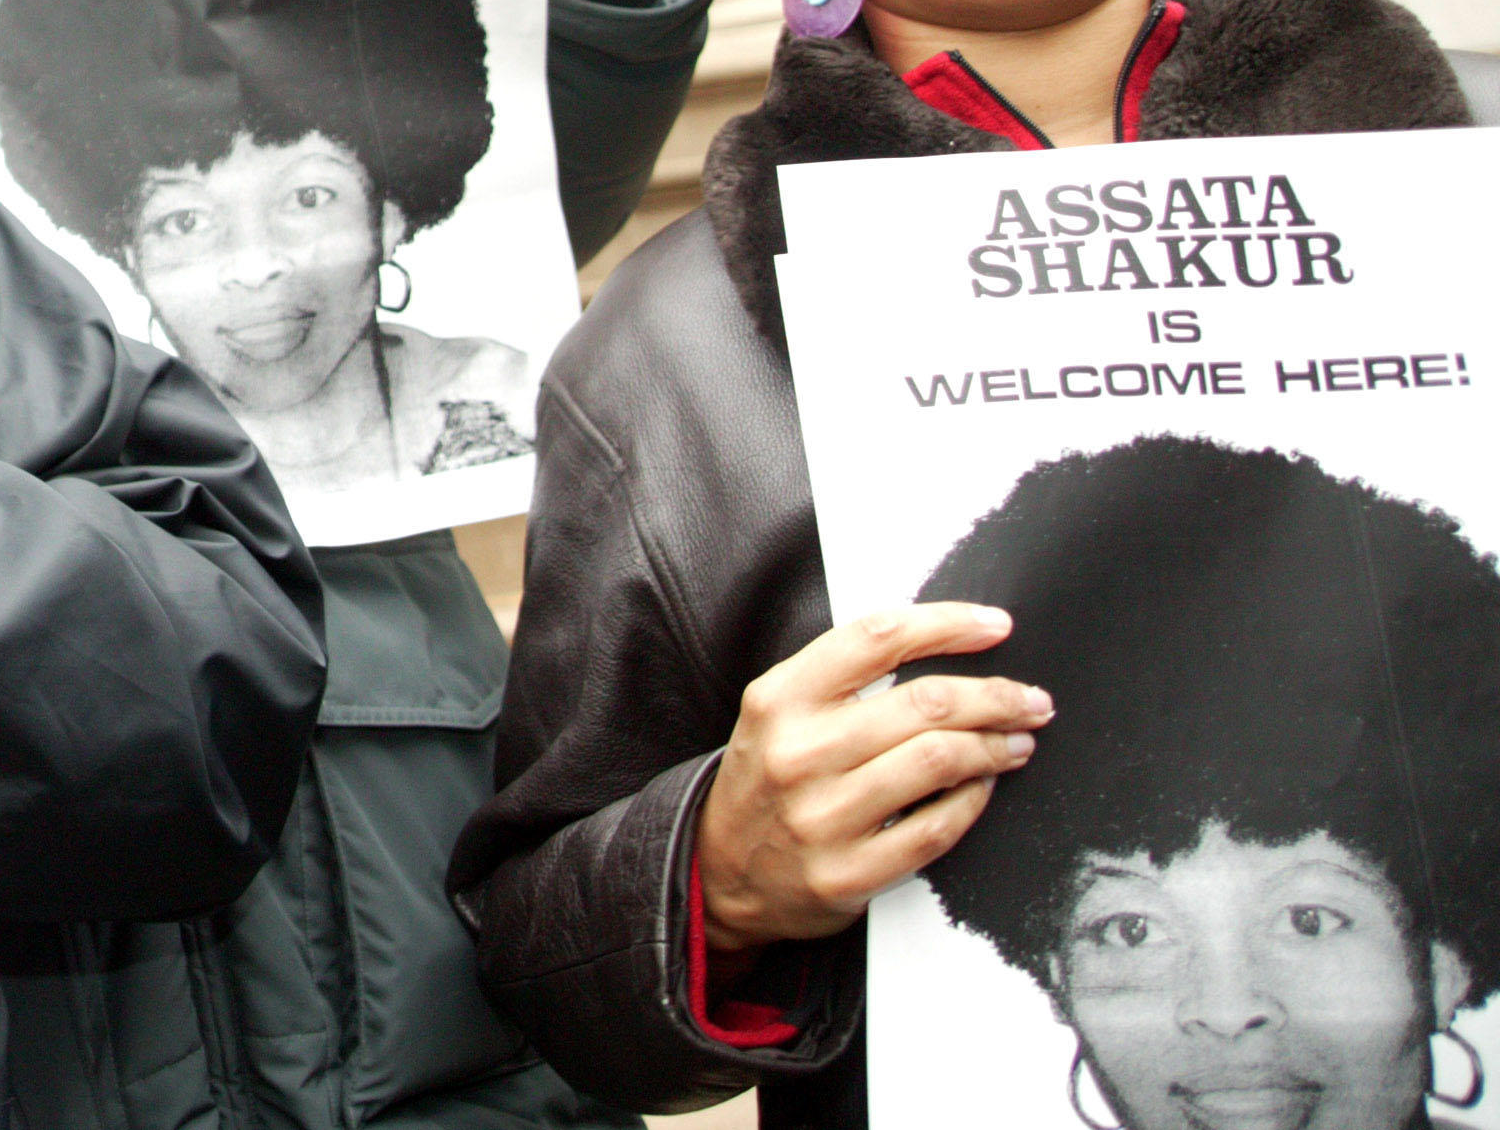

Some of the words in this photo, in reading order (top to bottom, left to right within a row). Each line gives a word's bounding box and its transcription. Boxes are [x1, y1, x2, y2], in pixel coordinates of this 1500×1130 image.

[985, 174, 1316, 241] ASSATA
[968, 231, 1355, 298] SHAKUR
[1147, 310, 1202, 344] IS
[904, 361, 1246, 407] WELCOME
[1274, 352, 1471, 394] HERE!
